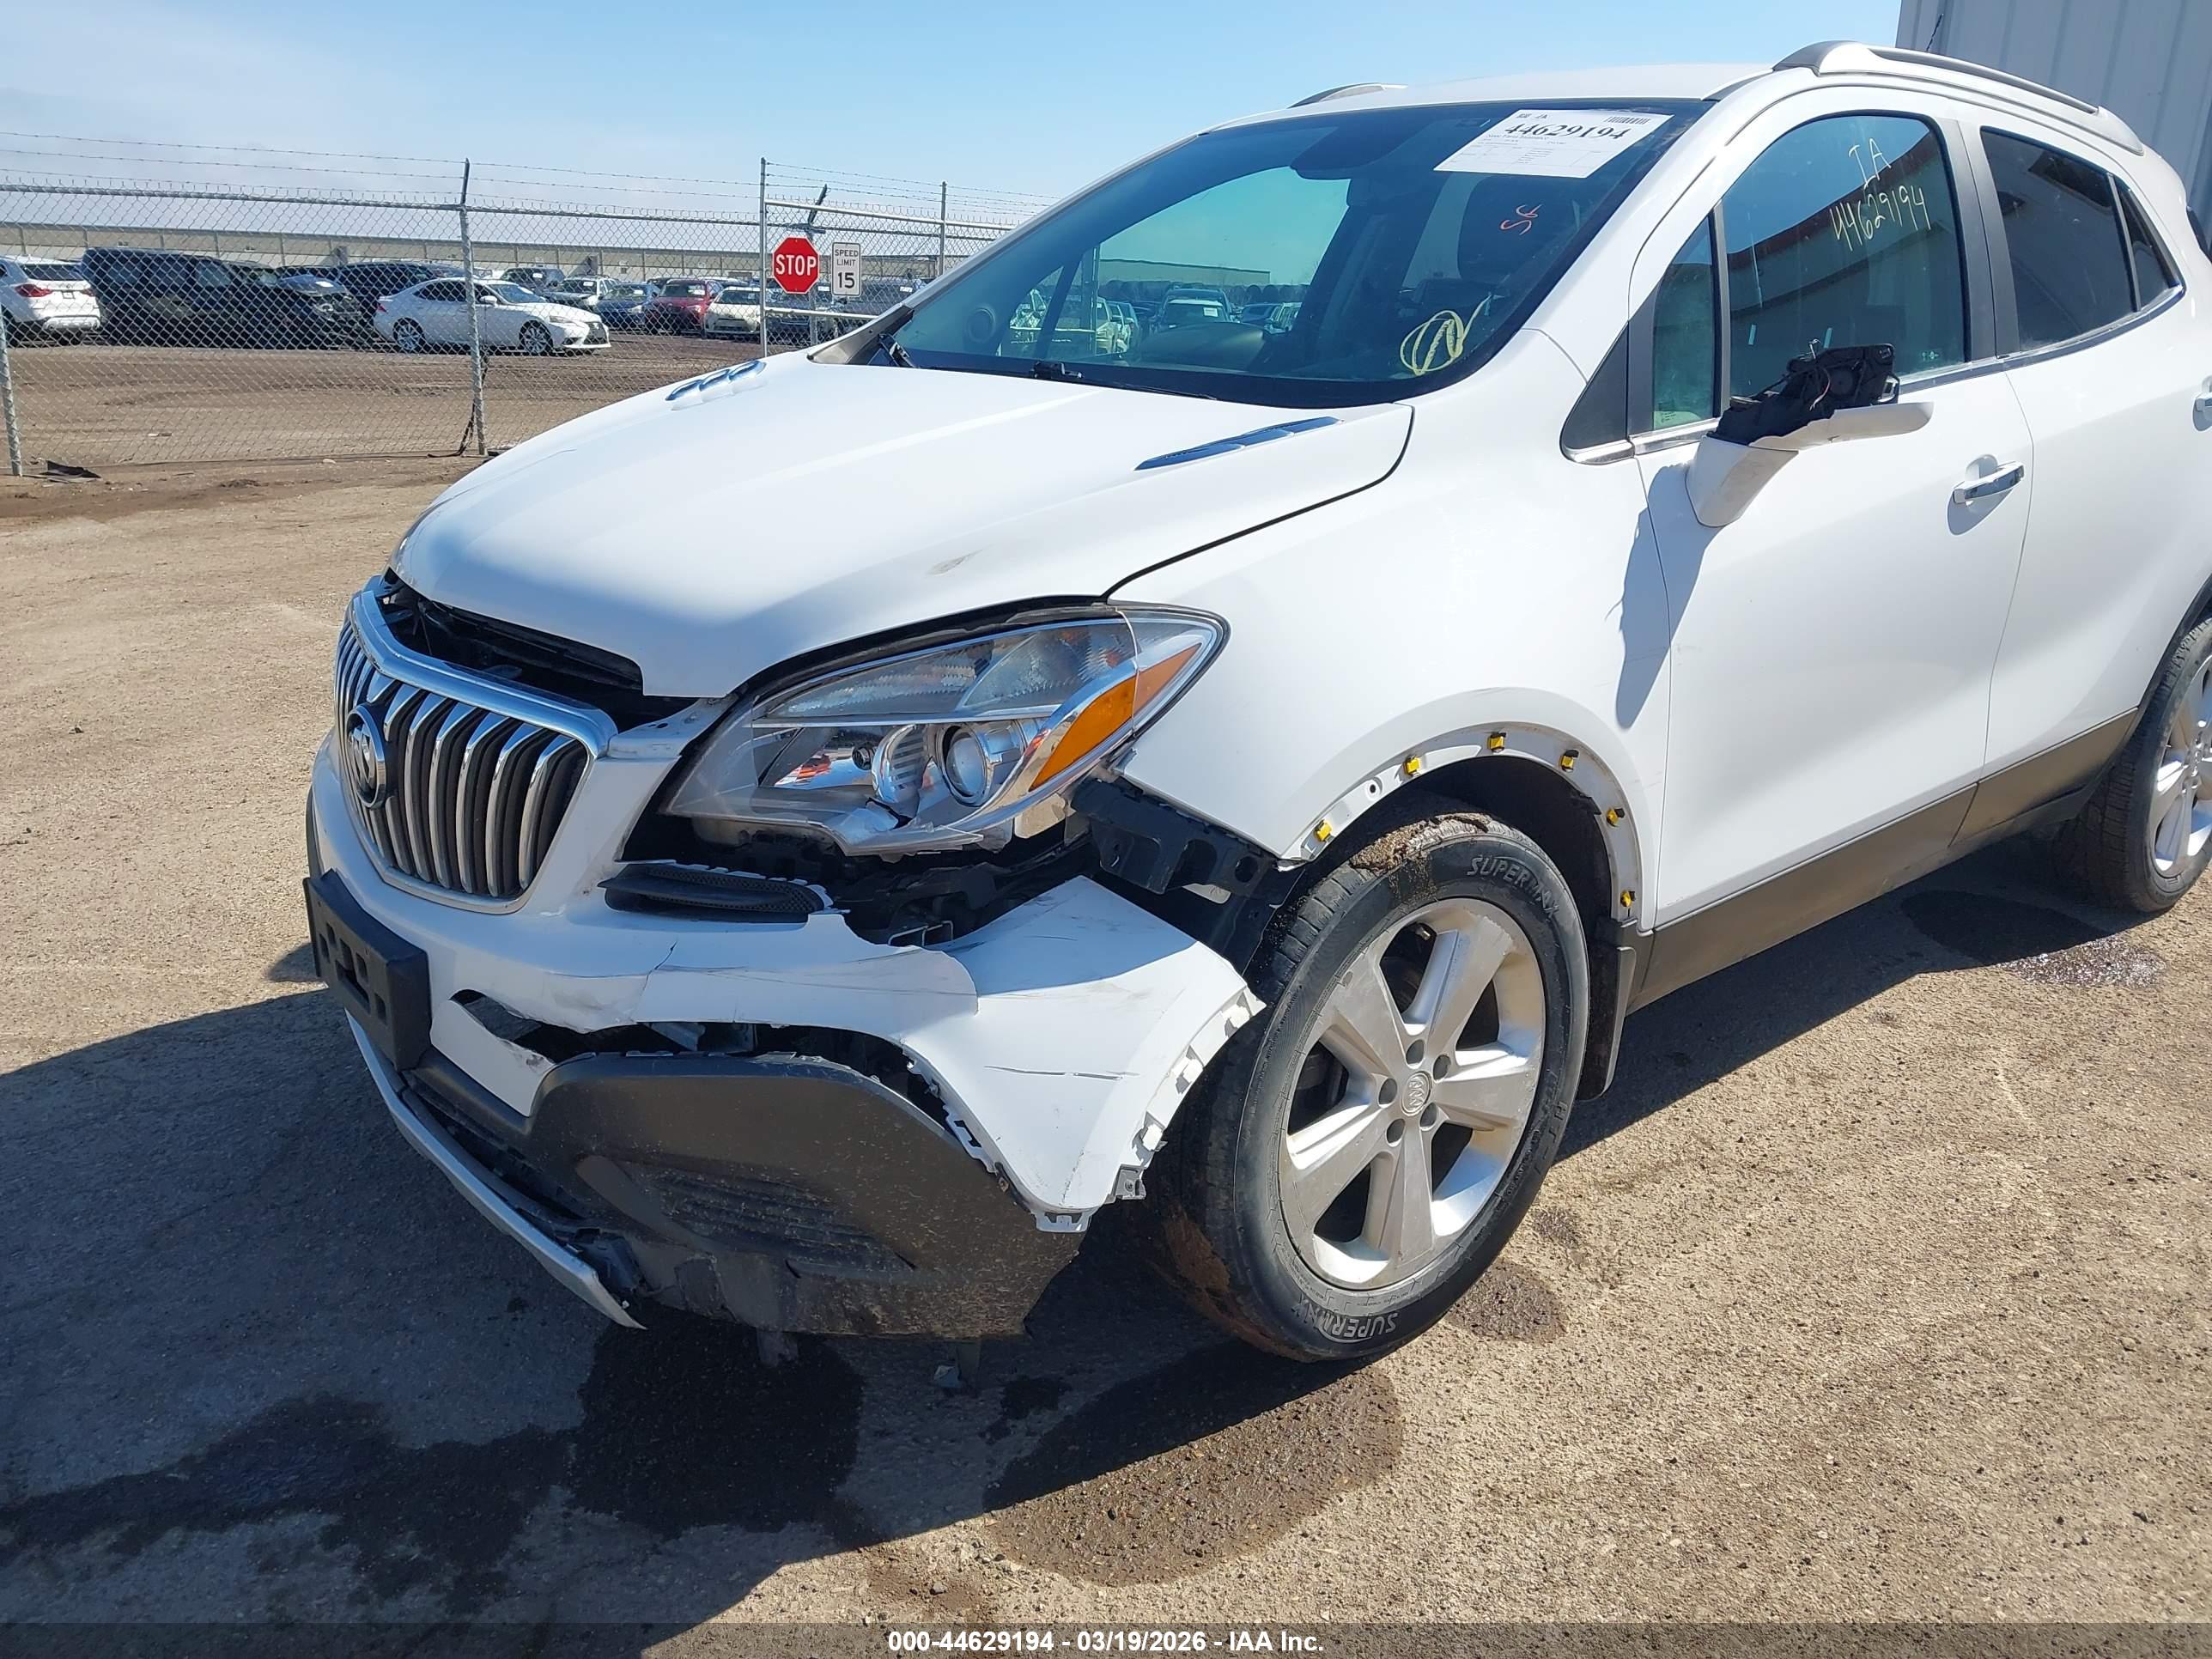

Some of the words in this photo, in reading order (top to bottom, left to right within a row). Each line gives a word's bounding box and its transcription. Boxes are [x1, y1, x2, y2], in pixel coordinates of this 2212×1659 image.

[1504, 123, 1632, 140] 44629194
[1830, 185, 1931, 252] 44629194
[834, 249, 859, 258] SPEED
[775, 250, 817, 276] STOP
[836, 258, 856, 267] LIMIT
[837, 272, 855, 289] 15
[1467, 854, 1559, 921] SUPERMAX
